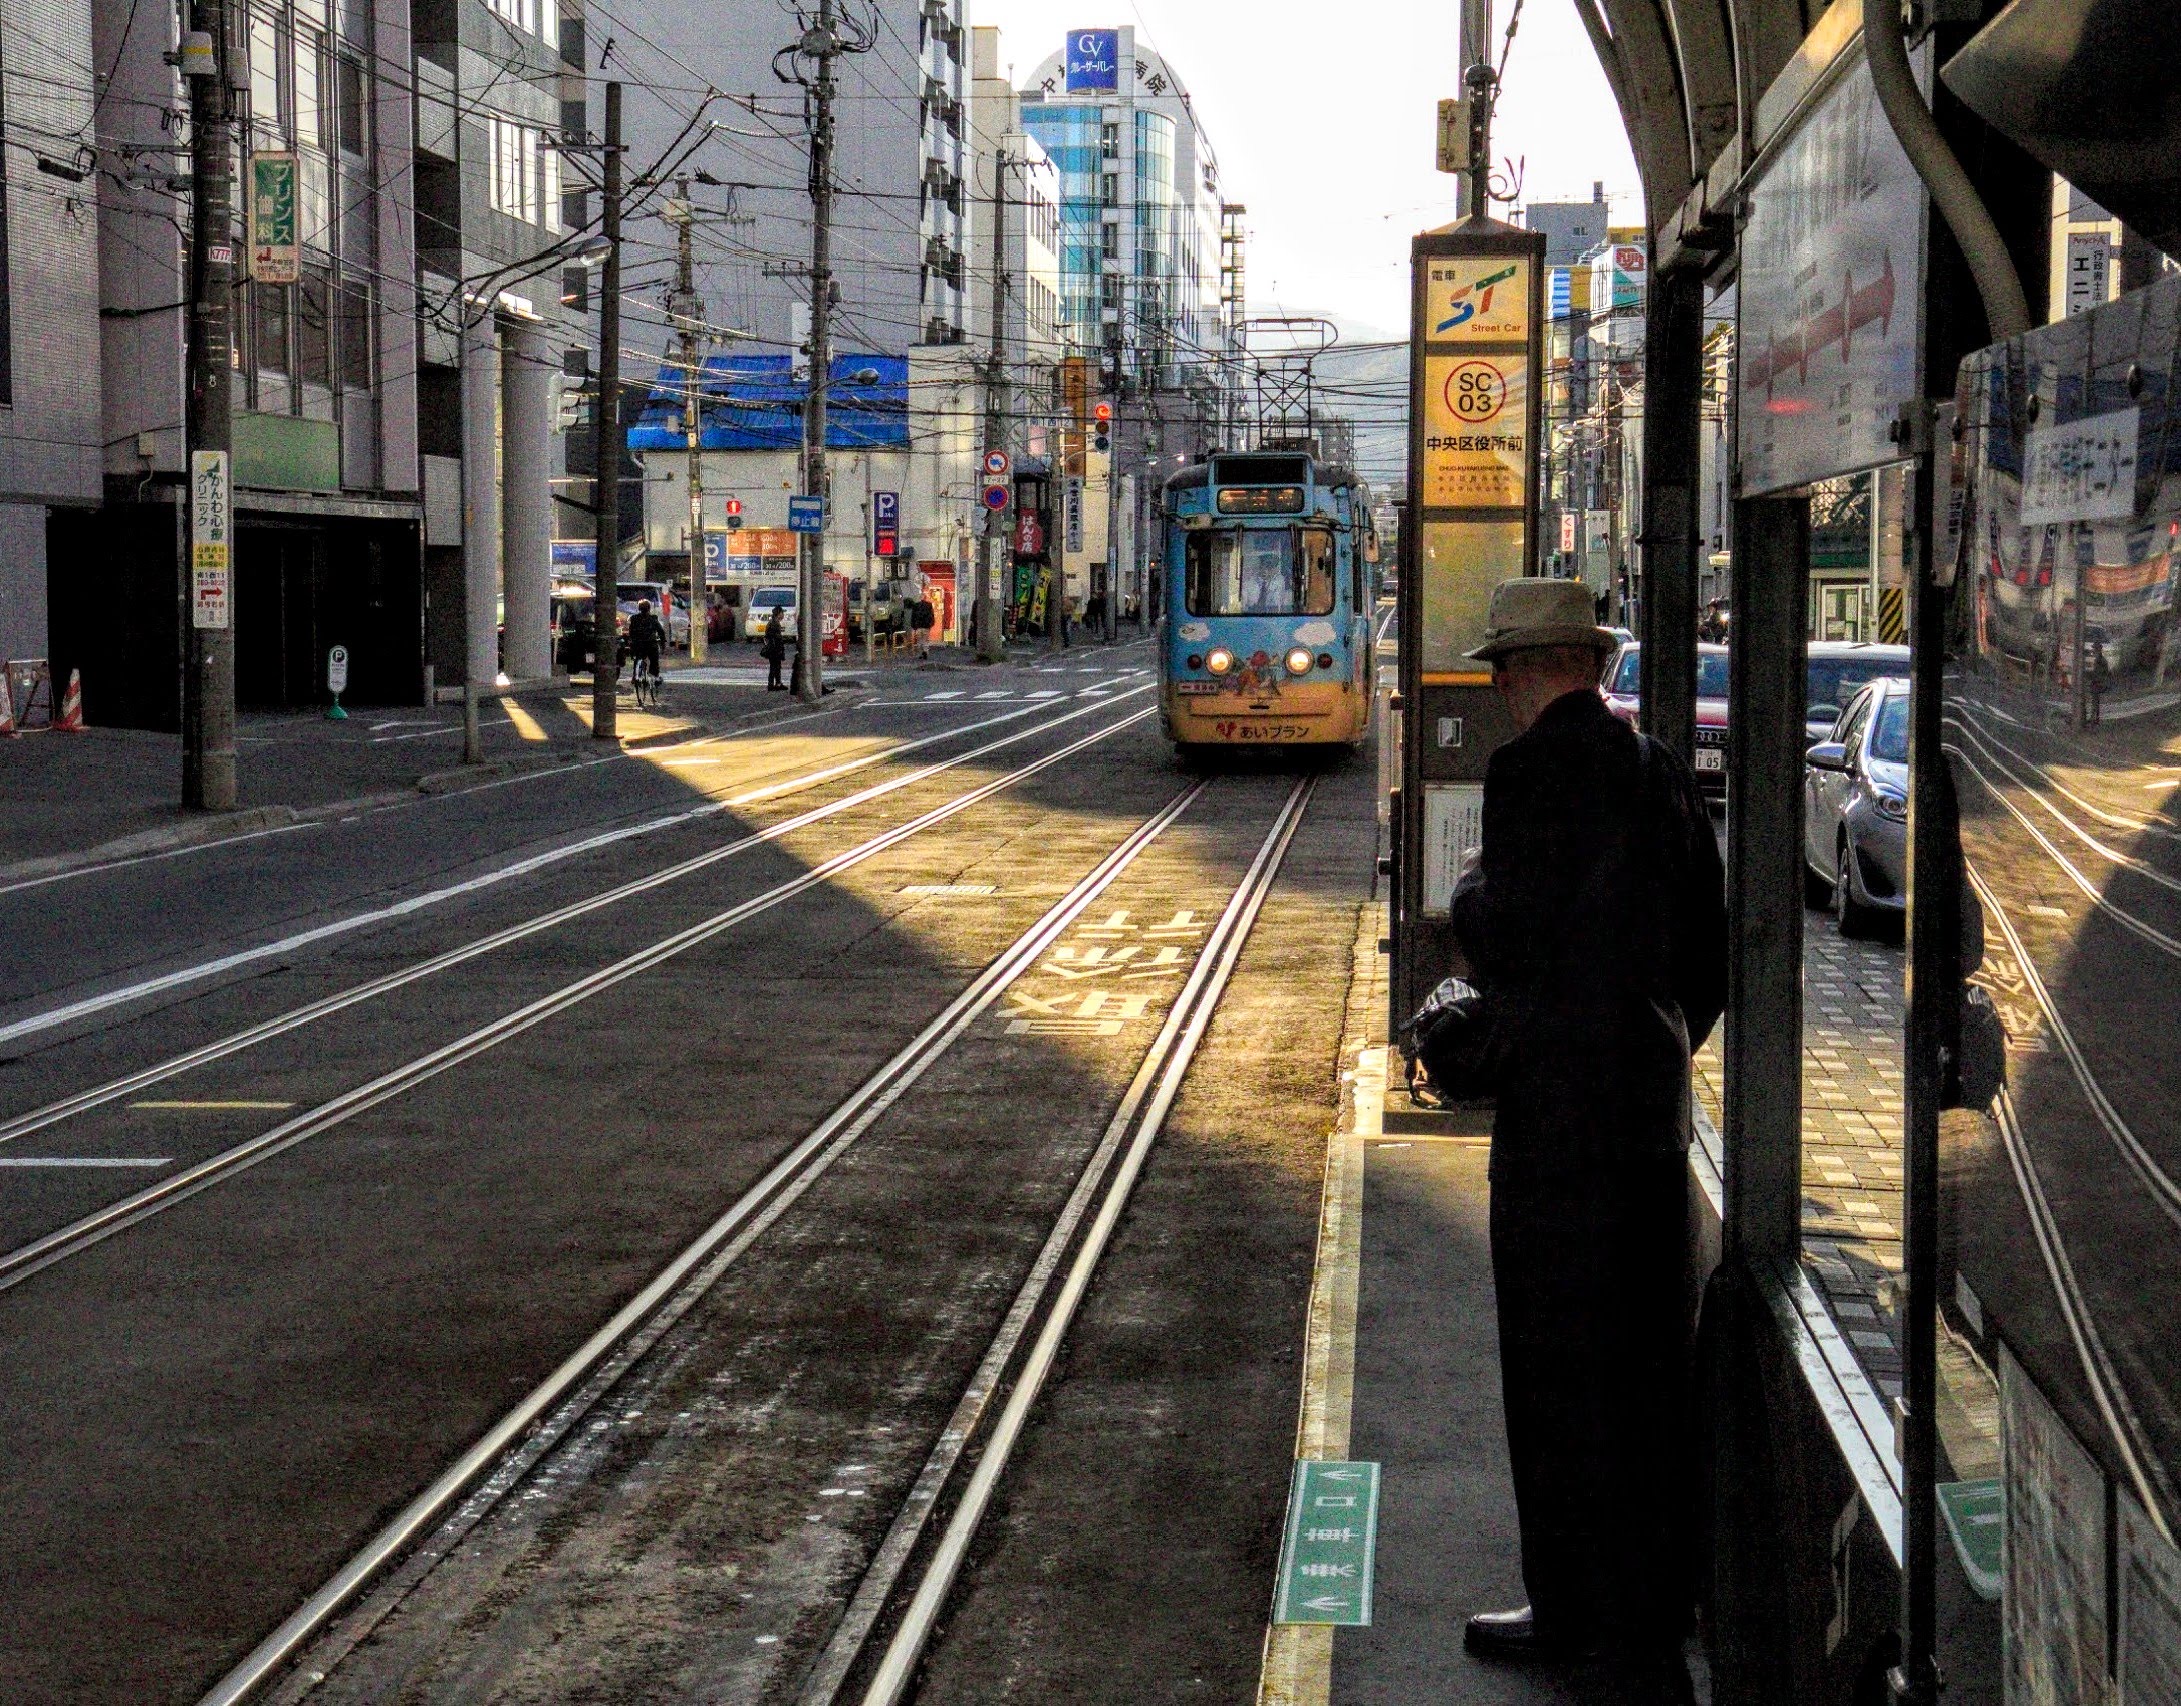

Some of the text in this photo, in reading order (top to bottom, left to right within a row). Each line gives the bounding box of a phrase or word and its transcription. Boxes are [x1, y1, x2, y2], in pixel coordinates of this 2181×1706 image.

[1078, 35, 1103, 58] CV
[275, 161, 292, 242] プリンス
[1431, 270, 1456, 281] 電車
[1471, 323, 1521, 333] Street Car
[1459, 372, 1492, 392] SC
[1458, 394, 1492, 412] 03
[1426, 436, 1524, 451] 中央区役所前
[197, 474, 208, 527] クリニック
[1564, 518, 1572, 549] くすり
[1240, 724, 1310, 739] あいプラン
